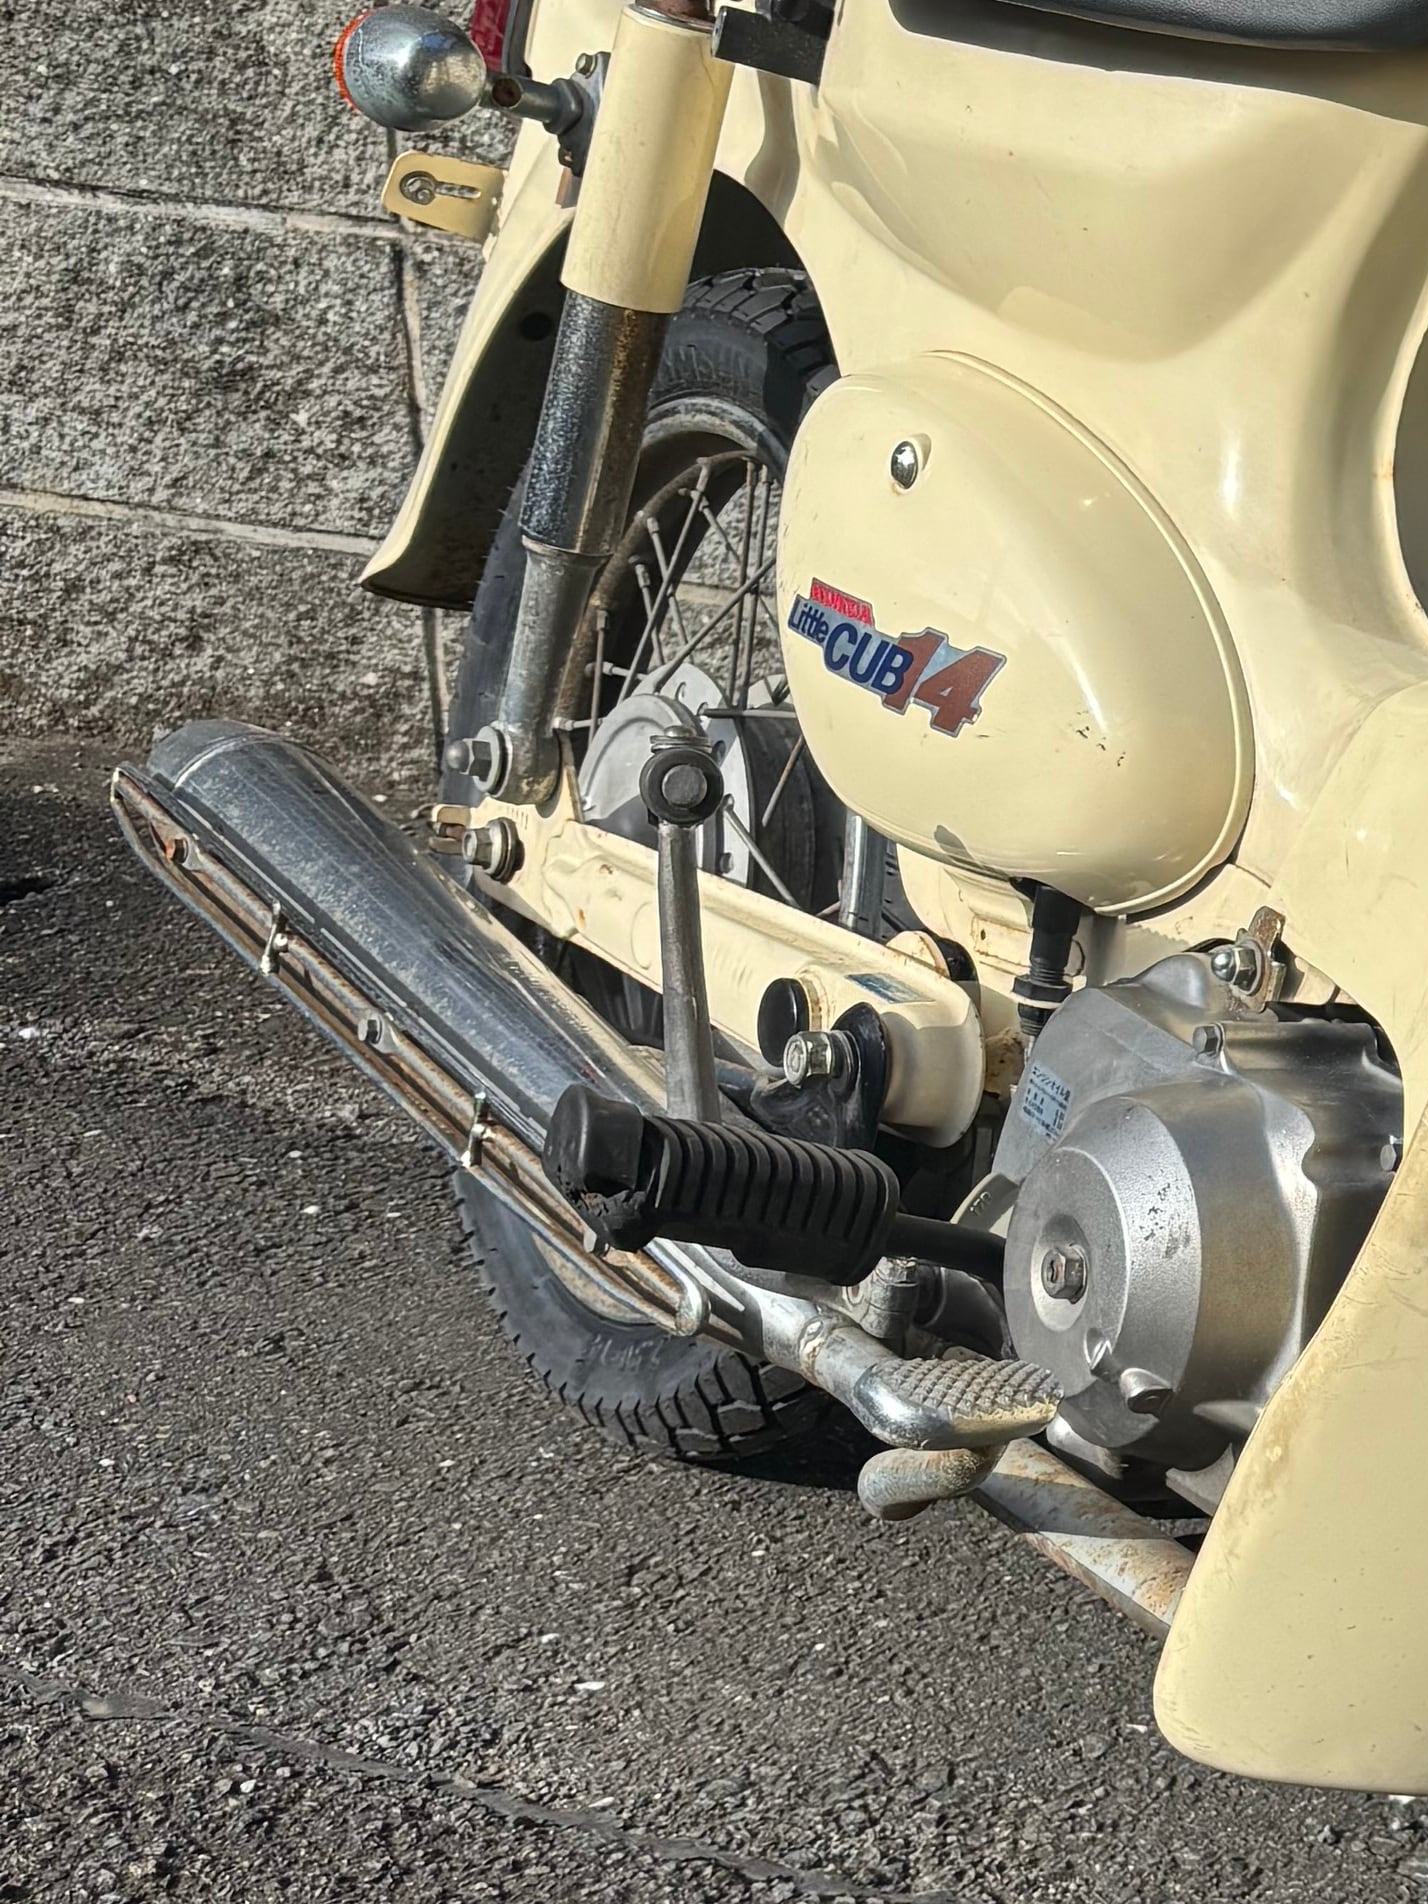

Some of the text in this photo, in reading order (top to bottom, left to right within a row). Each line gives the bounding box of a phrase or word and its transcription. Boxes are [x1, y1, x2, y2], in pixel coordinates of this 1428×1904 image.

[788, 597, 1006, 736] Little CUB 14
